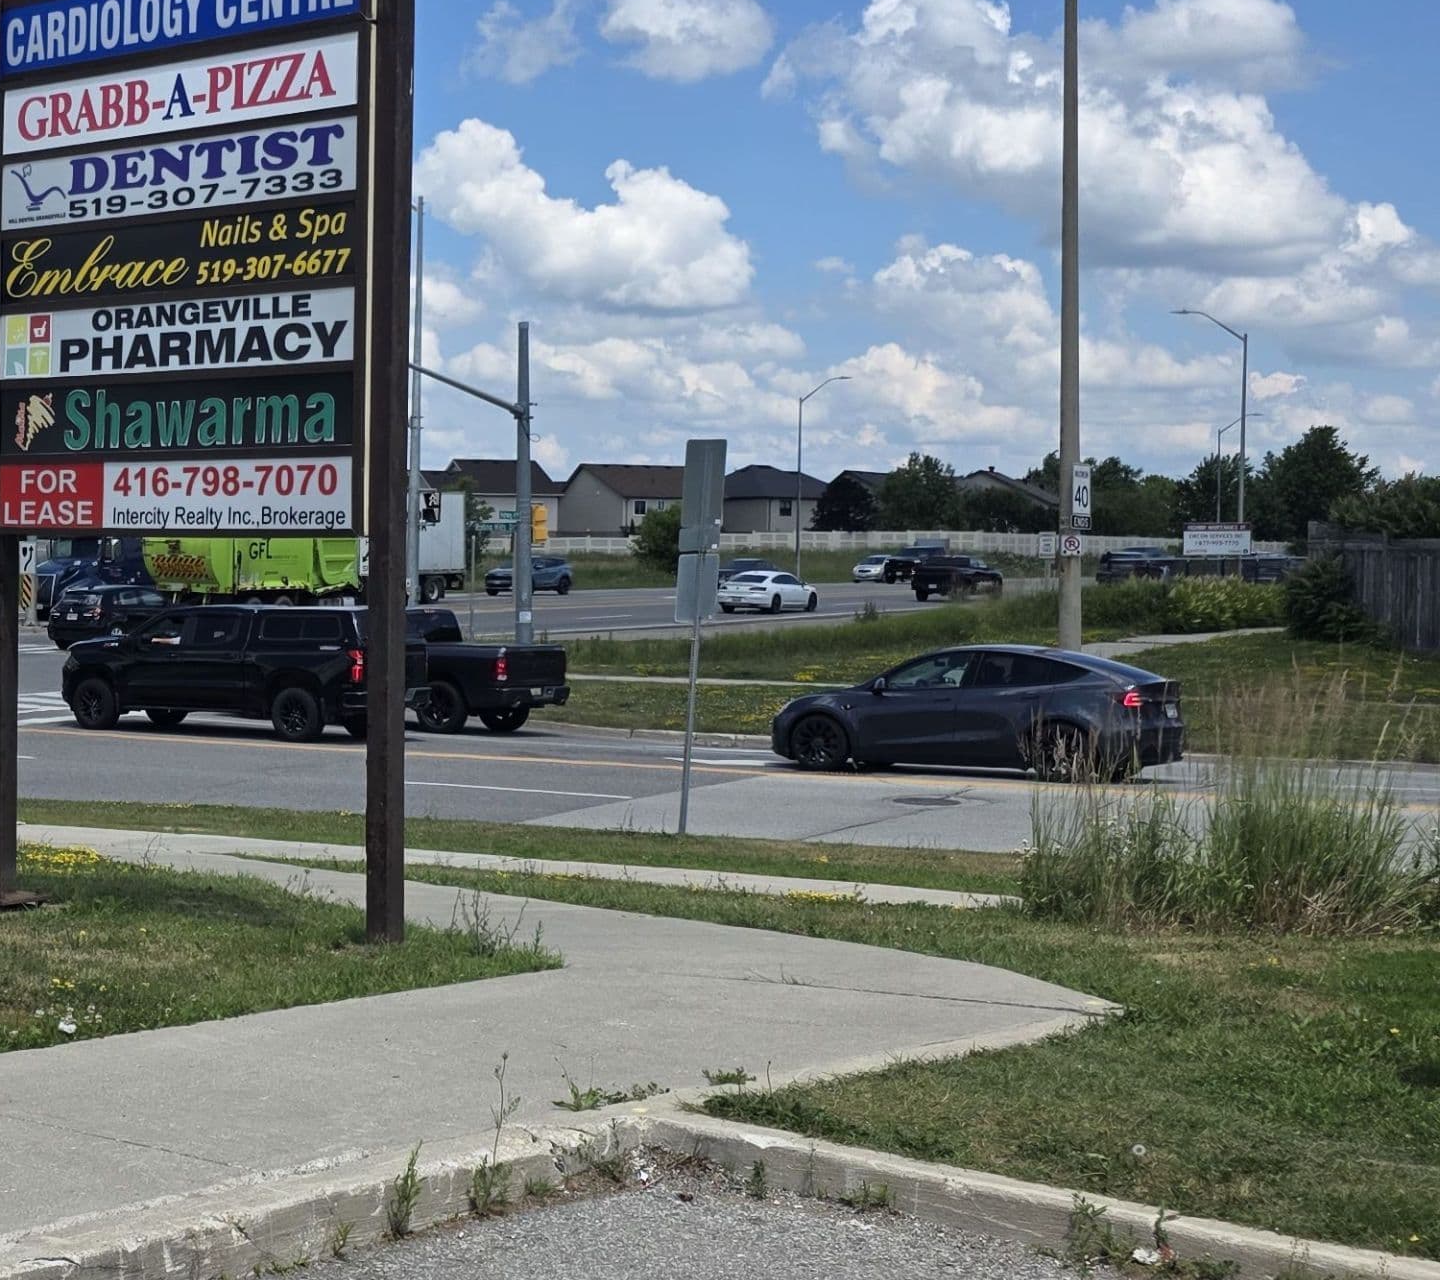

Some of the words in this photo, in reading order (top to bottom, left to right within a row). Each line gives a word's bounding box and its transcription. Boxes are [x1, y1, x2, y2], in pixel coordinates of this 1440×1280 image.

[17, 50, 336, 142] GRABB-A-PIZZA
[68, 124, 345, 196] DENTIST
[68, 168, 343, 219] 519-307-7333
[200, 218, 262, 248] Nails
[269, 213, 288, 241] &
[295, 208, 347, 245] Spa
[6, 234, 190, 299] Embrace
[196, 248, 351, 286] 519-307-6677
[91, 294, 312, 332] ORANGEVILLE
[59, 320, 348, 373] PHARMACY
[63, 389, 336, 452] Shawarma
[20, 469, 78, 494] FOR
[113, 463, 338, 497] 416-798-7070
[1074, 485, 1089, 508] 40
[3, 500, 94, 526] LEASE
[112, 506, 170, 530] Intercity
[174, 506, 223, 530] Realty
[249, 539, 272, 559] GFL
